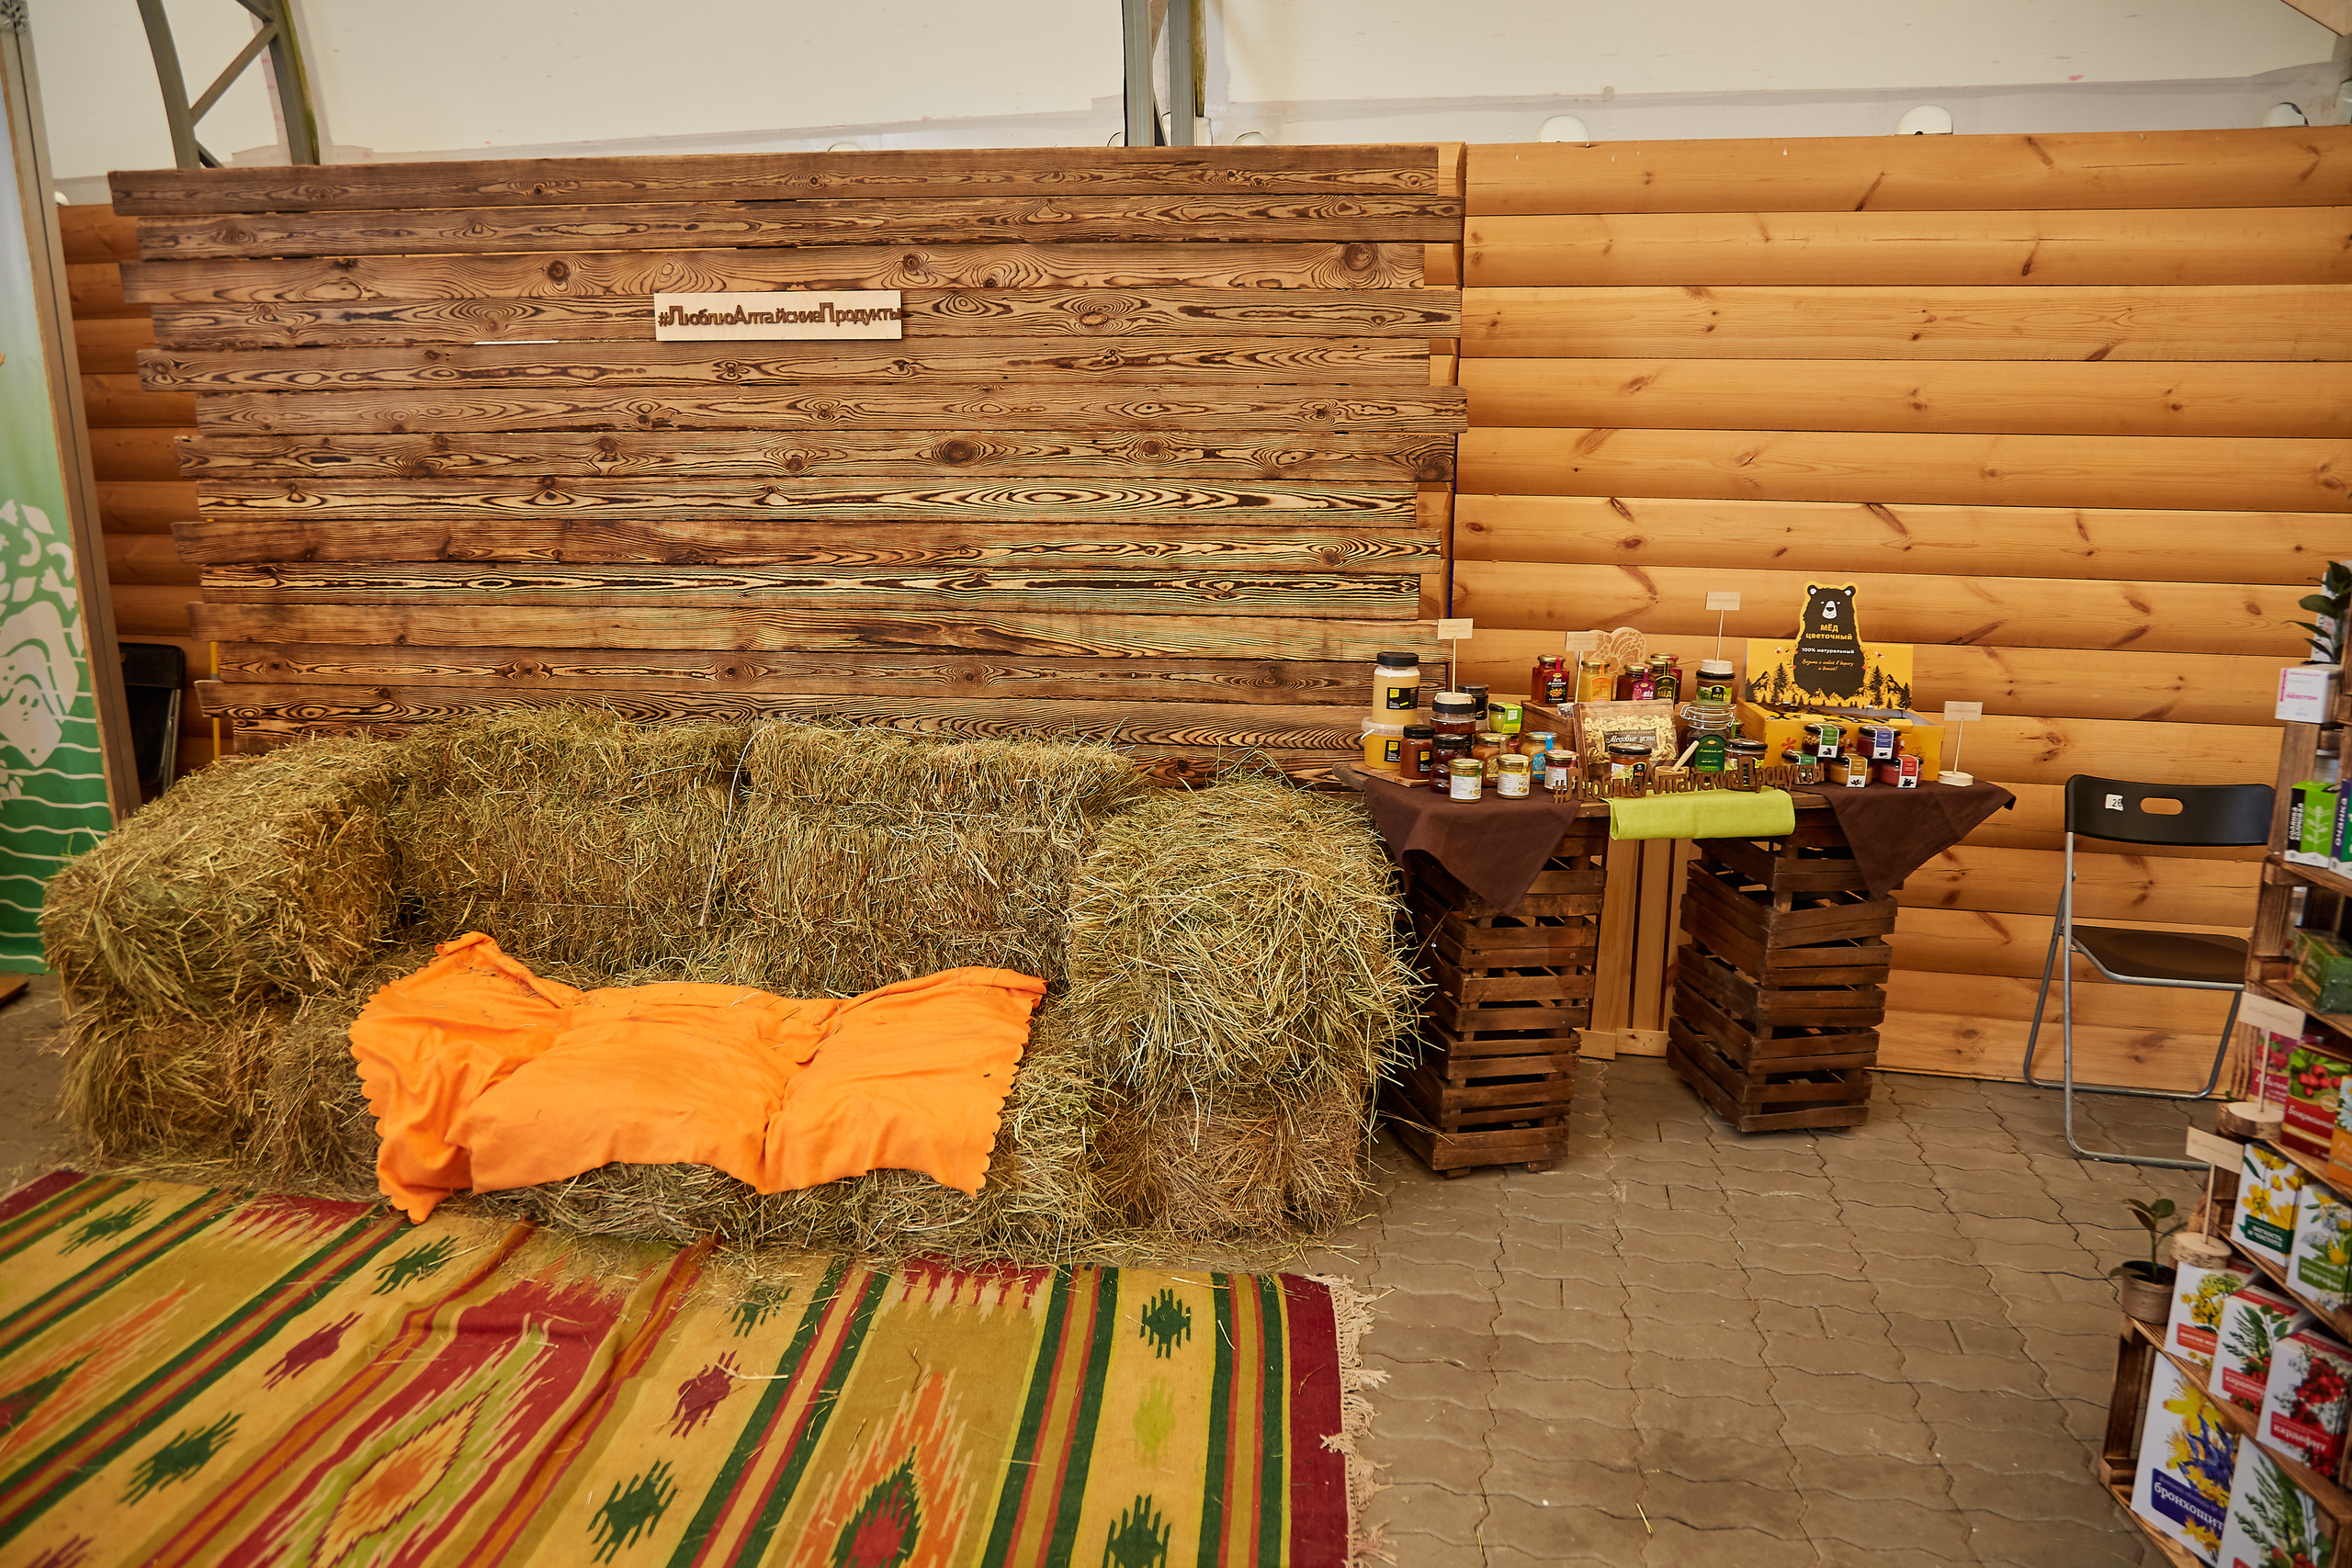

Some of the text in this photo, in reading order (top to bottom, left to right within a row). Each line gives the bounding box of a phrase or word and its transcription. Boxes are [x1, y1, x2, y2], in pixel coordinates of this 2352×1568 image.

[658, 302, 902, 327] #ЛюблюАлтайскиеПродукты
[1820, 624, 1839, 633] МЁД
[1605, 735, 1638, 744] Медовые
[2154, 1482, 2223, 1530] бронхощит
